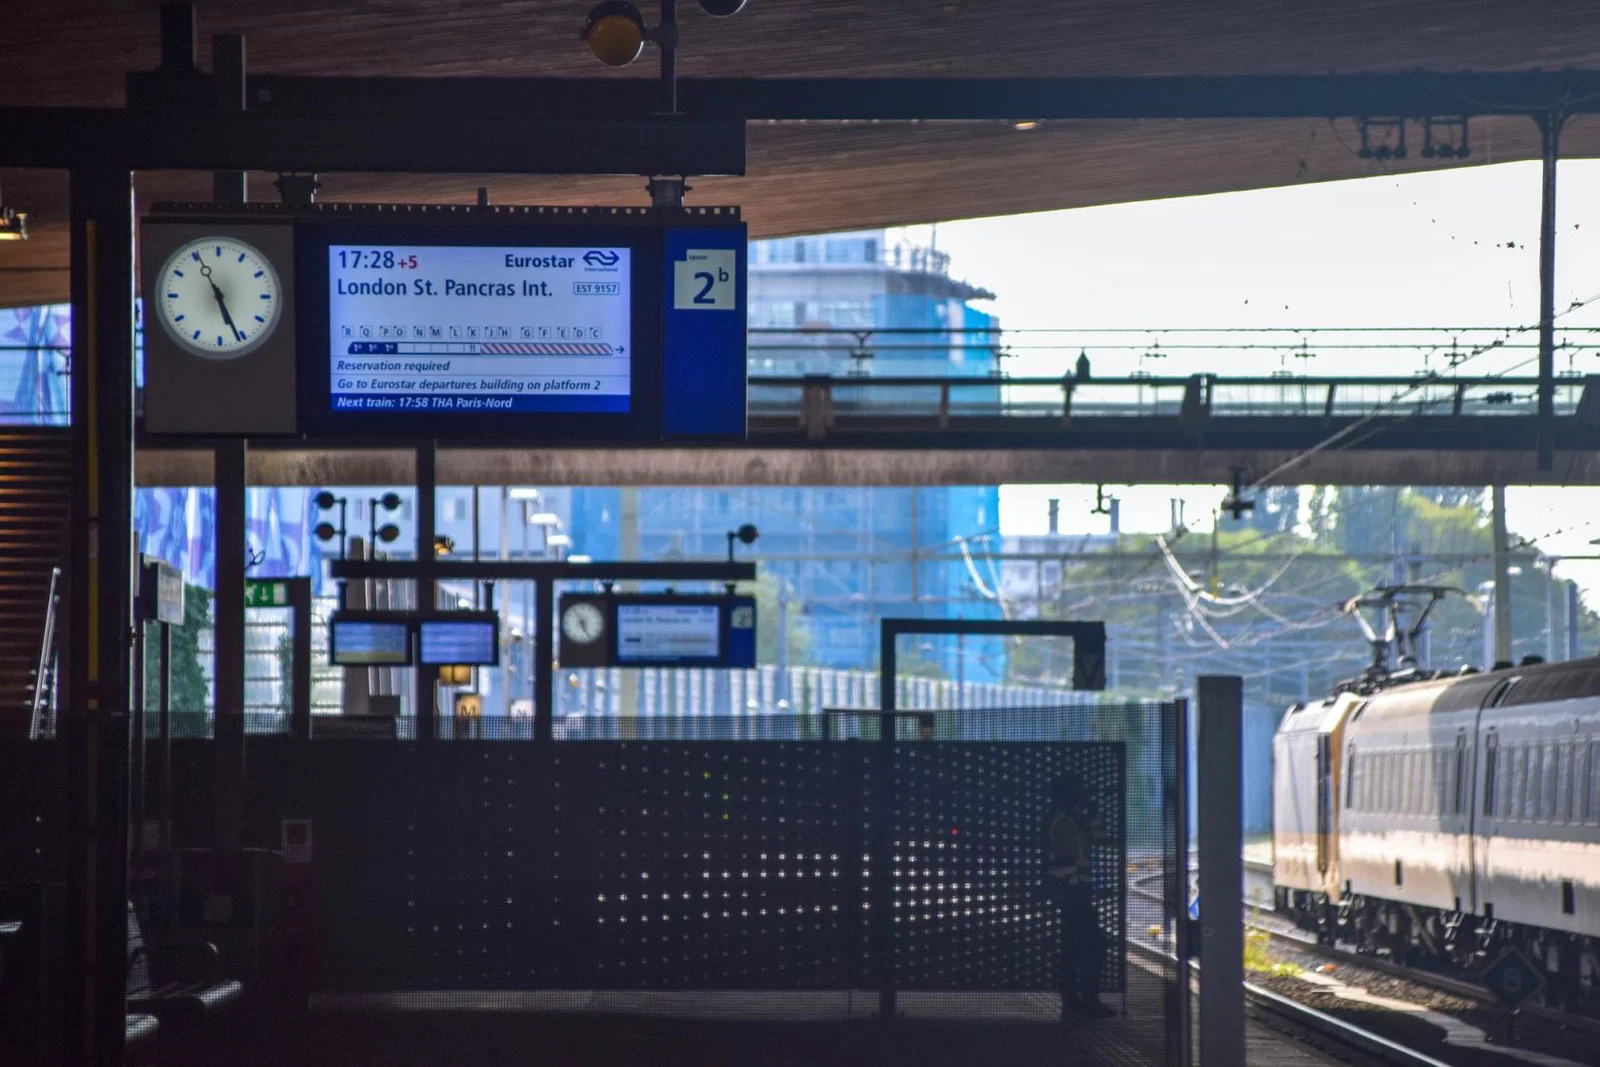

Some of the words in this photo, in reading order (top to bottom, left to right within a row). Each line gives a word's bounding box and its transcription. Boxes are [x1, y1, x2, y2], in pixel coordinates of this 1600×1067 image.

[338, 251, 395, 268] 17:28
[397, 255, 418, 269] +5
[505, 254, 575, 268] Eurostar
[338, 278, 406, 295] London
[414, 278, 438, 296] St.
[445, 279, 516, 296] Pancras
[523, 280, 552, 296] Int.
[576, 284, 592, 292] EST
[594, 284, 616, 292] 9157
[470, 329, 476, 337] K
[502, 329, 508, 337] H
[524, 329, 531, 337] G
[543, 329, 548, 337] F
[561, 329, 566, 337] E
[576, 329, 583, 337] D
[593, 329, 599, 337] C
[338, 360, 402, 370] Reservation
[404, 360, 450, 372] required
[338, 379, 353, 388] Go
[356, 380, 368, 388] to
[370, 380, 416, 389] Eurostar
[419, 379, 477, 392] departures
[480, 380, 524, 392] building
[544, 380, 591, 392] platform
[594, 380, 601, 390] 2
[337, 397, 363, 407] Next
[366, 397, 396, 407] train:
[400, 398, 429, 408] 17:58
[432, 398, 453, 408] THA
[456, 397, 513, 408] Paris-Nord
